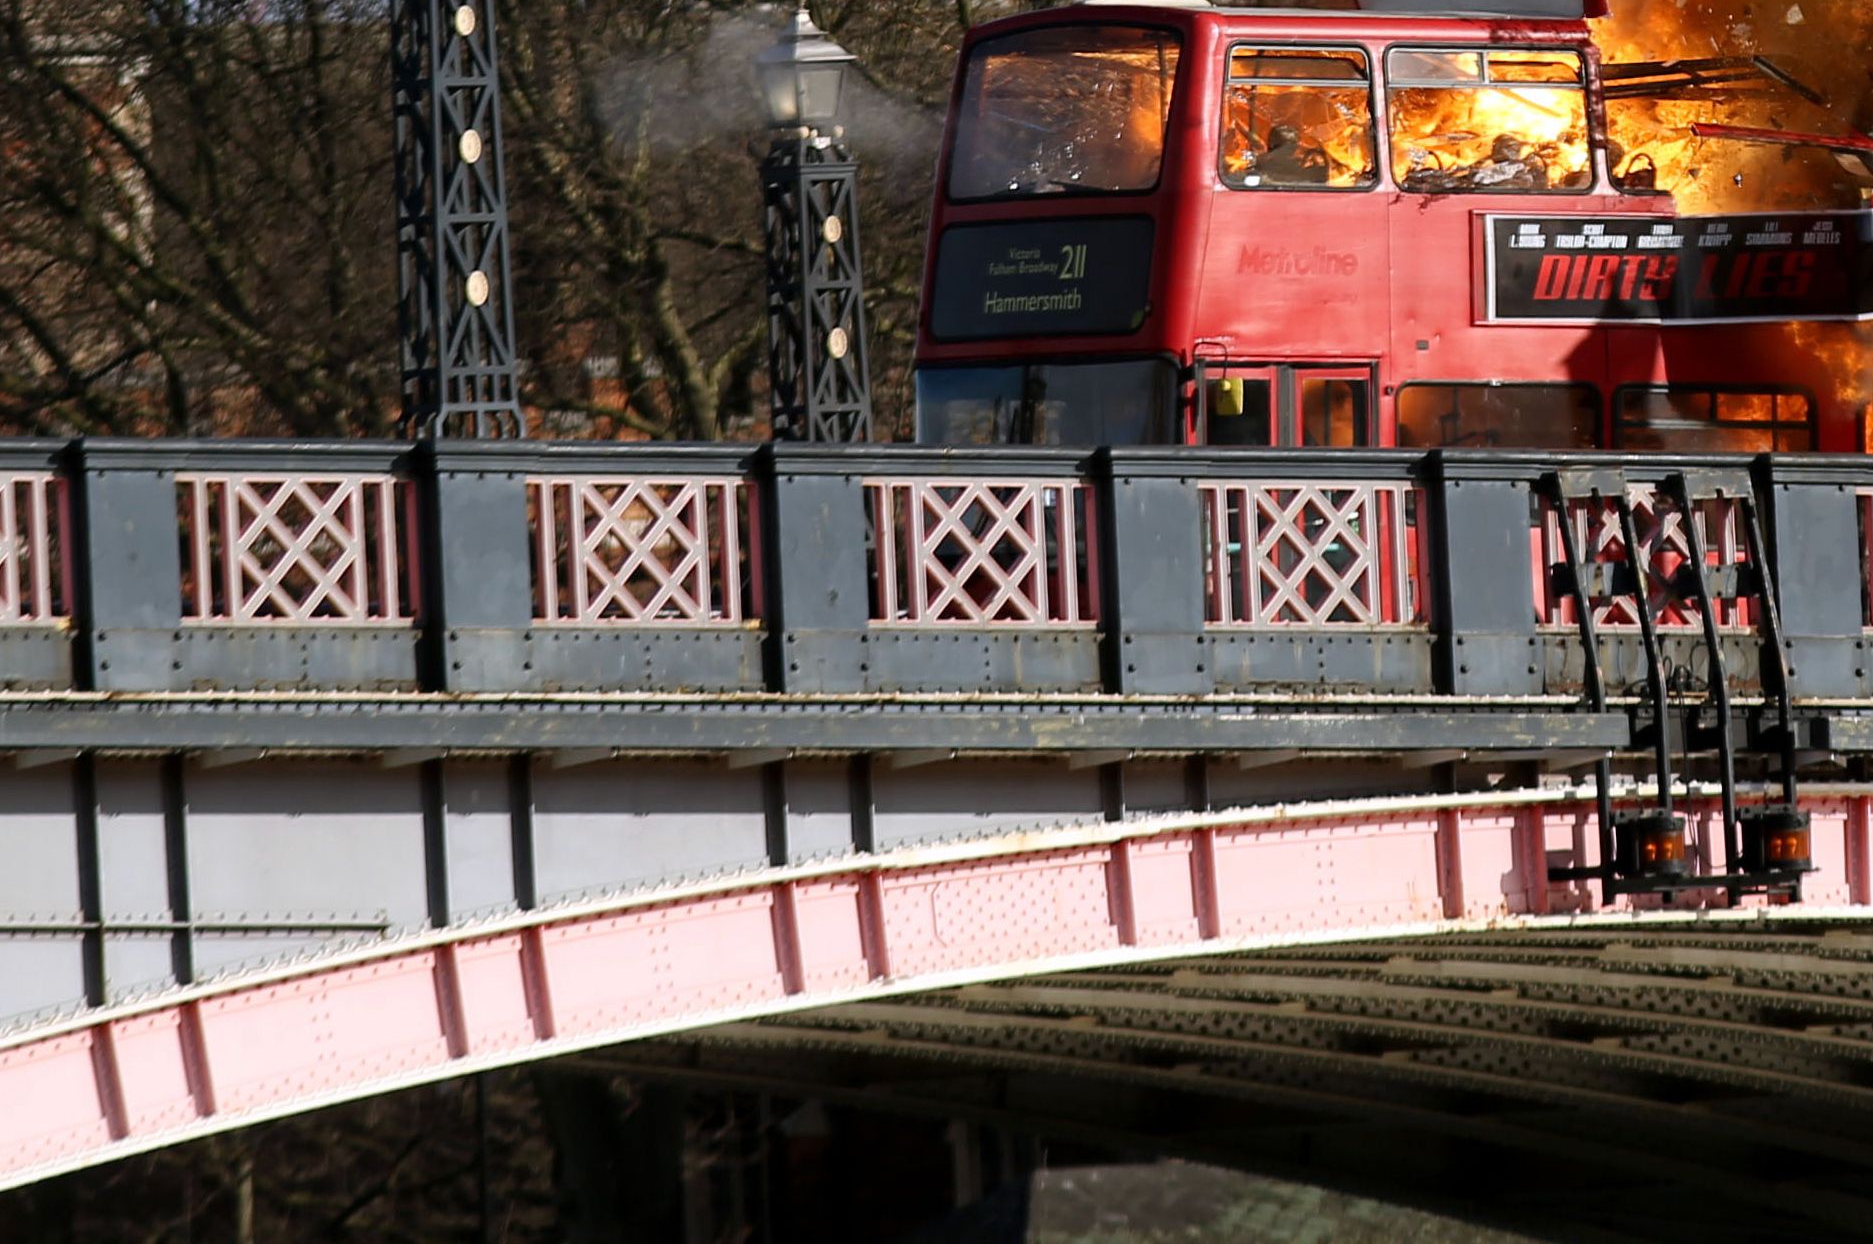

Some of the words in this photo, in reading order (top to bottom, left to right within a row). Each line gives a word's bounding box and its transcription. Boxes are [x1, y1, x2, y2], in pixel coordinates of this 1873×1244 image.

[1058, 244, 1088, 279] 211
[1533, 254, 1679, 301] DIRTY
[1695, 252, 1815, 299] LIES
[984, 287, 1082, 314] Hammersmith
